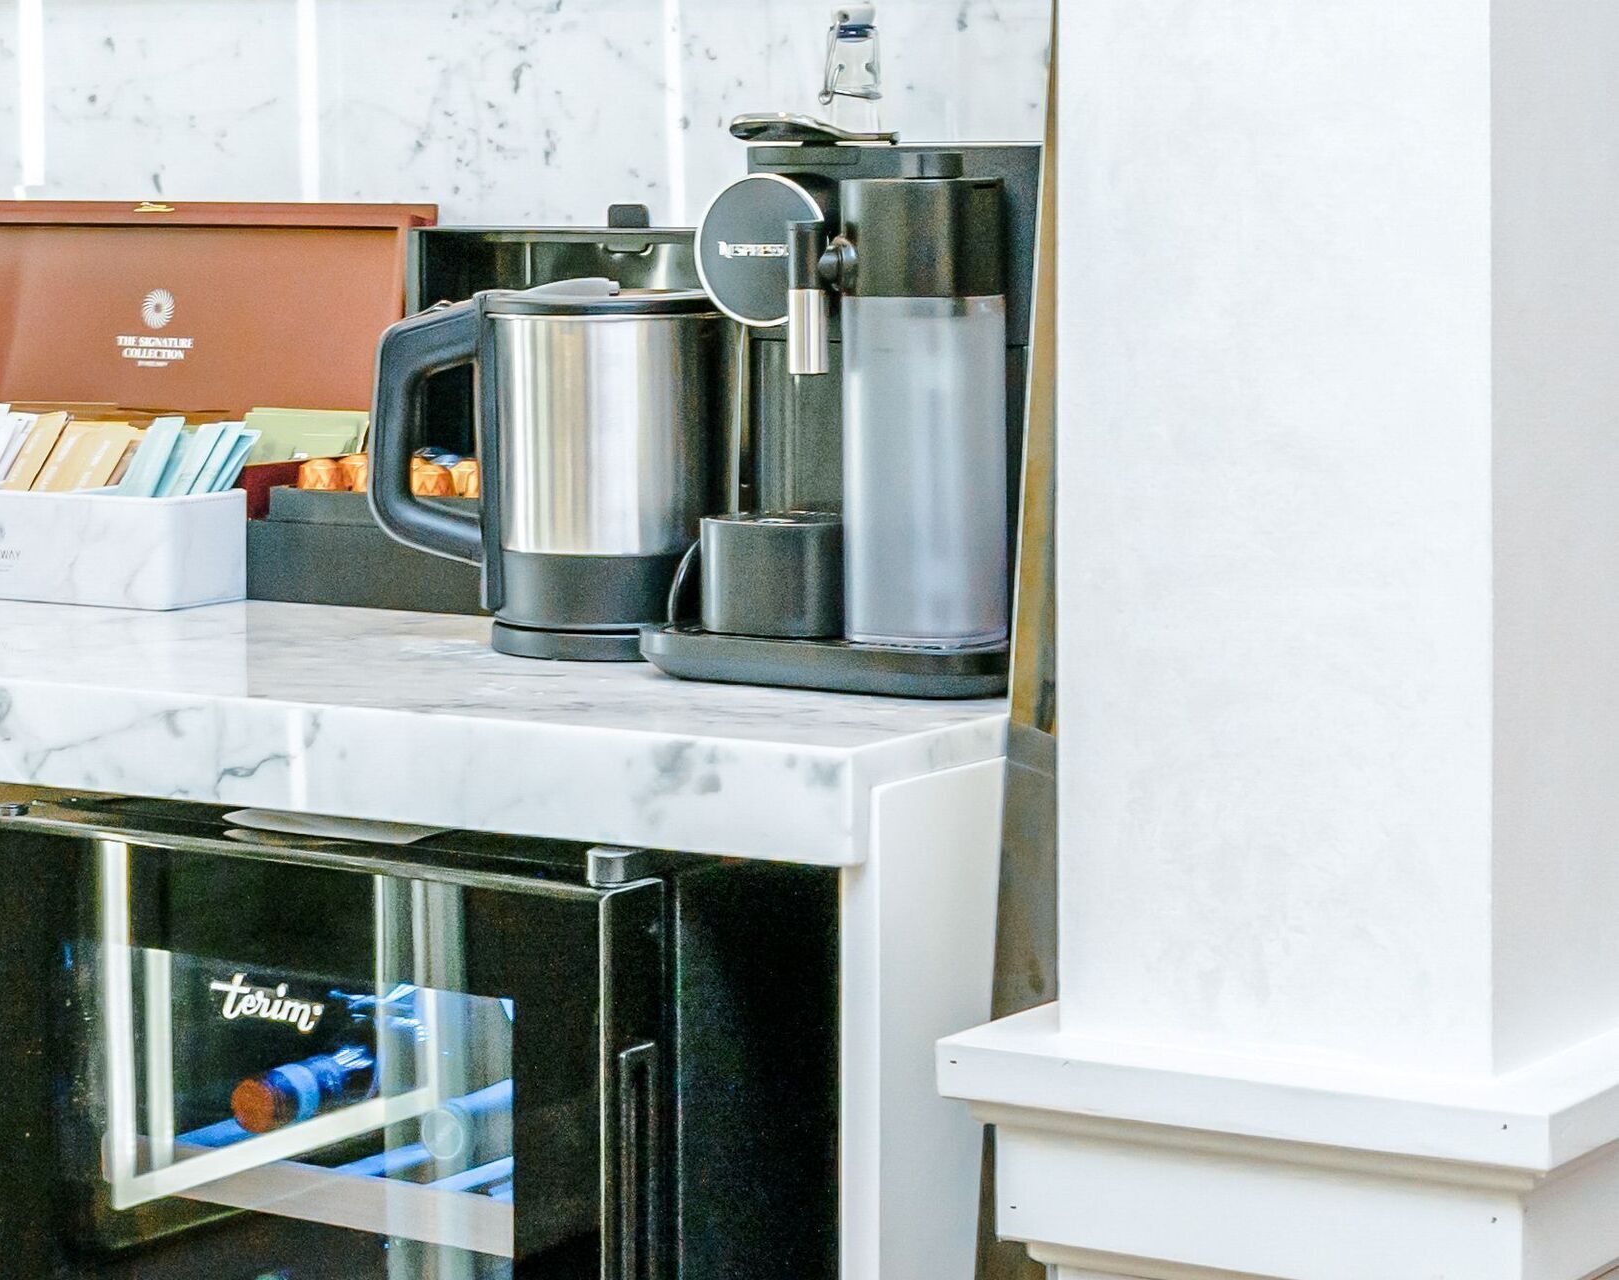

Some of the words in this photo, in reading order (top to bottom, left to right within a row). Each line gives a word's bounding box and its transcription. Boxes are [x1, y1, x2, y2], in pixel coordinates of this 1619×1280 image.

[116, 335, 138, 347] THE
[139, 336, 194, 348] SIGNATURE
[122, 348, 185, 360] COLLECTION
[210, 973, 319, 1032] terim
